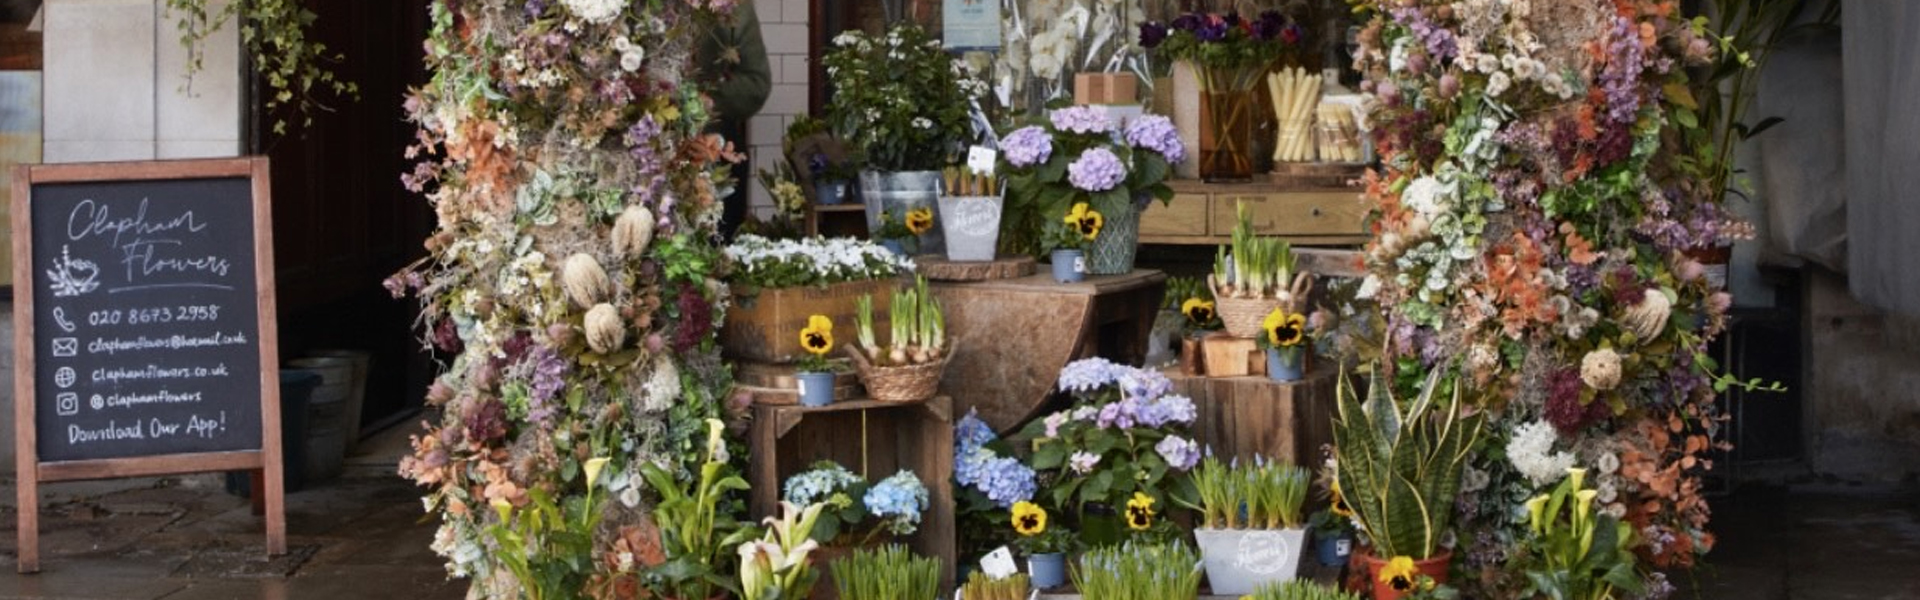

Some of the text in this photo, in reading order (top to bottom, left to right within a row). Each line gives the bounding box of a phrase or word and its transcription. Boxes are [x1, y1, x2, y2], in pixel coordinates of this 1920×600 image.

[67, 197, 207, 249] Clapham
[121, 237, 230, 283] Flowers
[88, 305, 221, 326] 020 8673 2958
[92, 363, 229, 383] claphamflowers.co.uk
[106, 390, 202, 409] claphamflowers
[68, 411, 226, 445] Download Our App!
